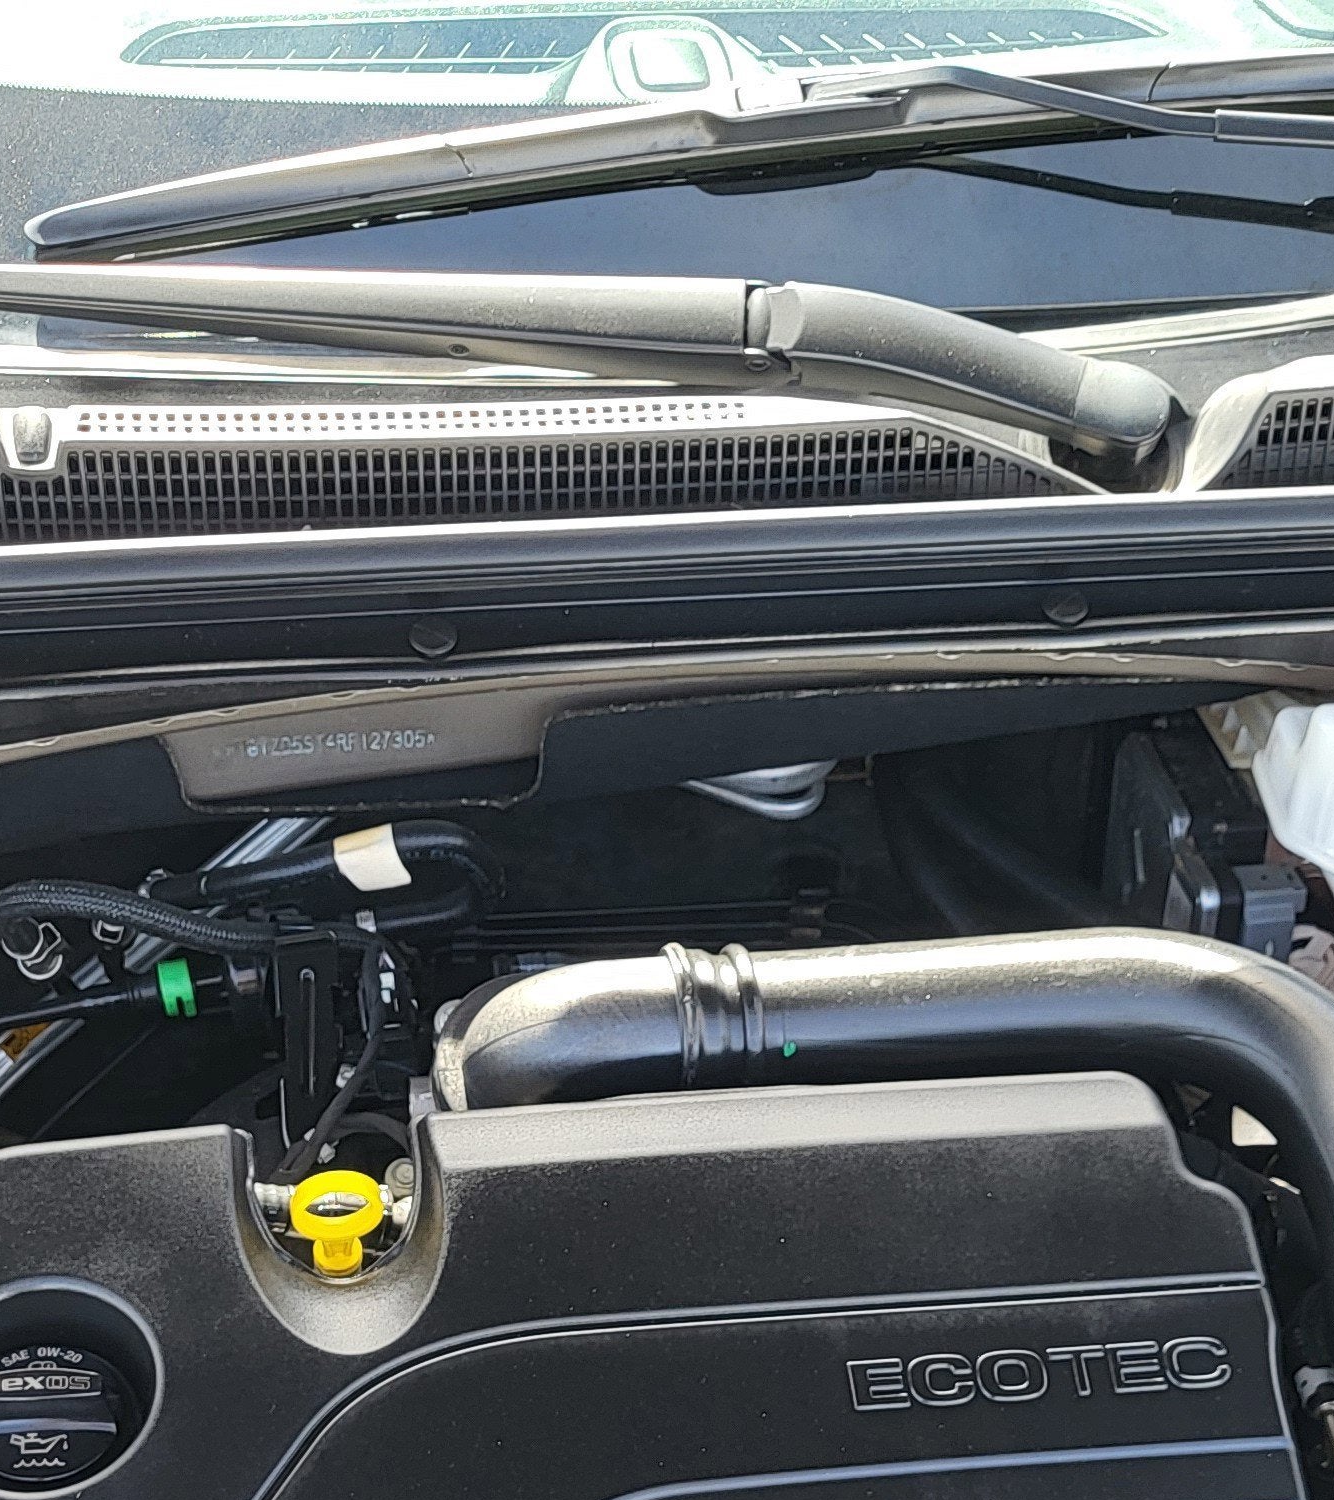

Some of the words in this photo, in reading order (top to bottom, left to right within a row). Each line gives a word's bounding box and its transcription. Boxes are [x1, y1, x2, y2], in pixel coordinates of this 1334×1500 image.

[1, 1349, 30, 1367] SAE
[37, 1346, 83, 1363] 0W-20
[844, 1335, 1234, 1411] ECOTEC
